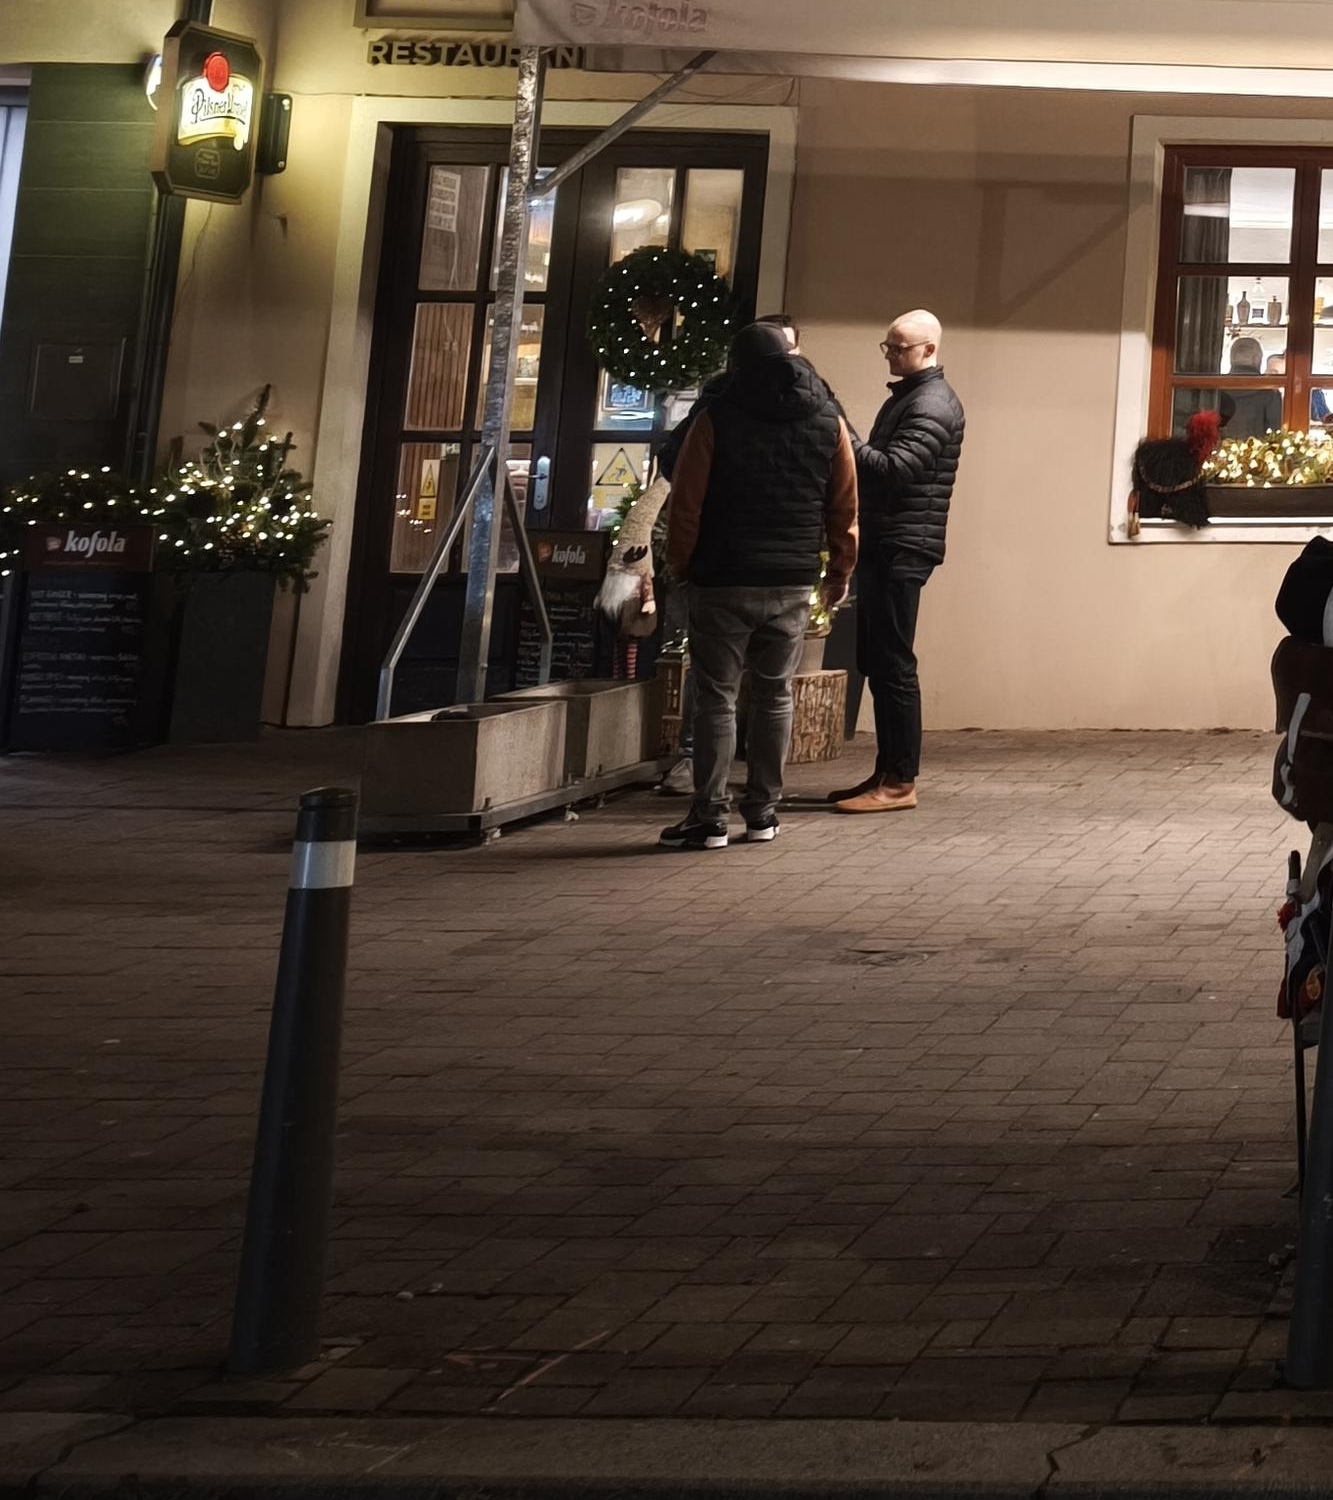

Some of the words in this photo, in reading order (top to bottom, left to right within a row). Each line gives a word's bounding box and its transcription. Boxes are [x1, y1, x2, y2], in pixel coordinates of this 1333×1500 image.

[369, 41, 584, 69] RESTAURN
[64, 530, 126, 558] kofola
[552, 544, 586, 568] kofola
